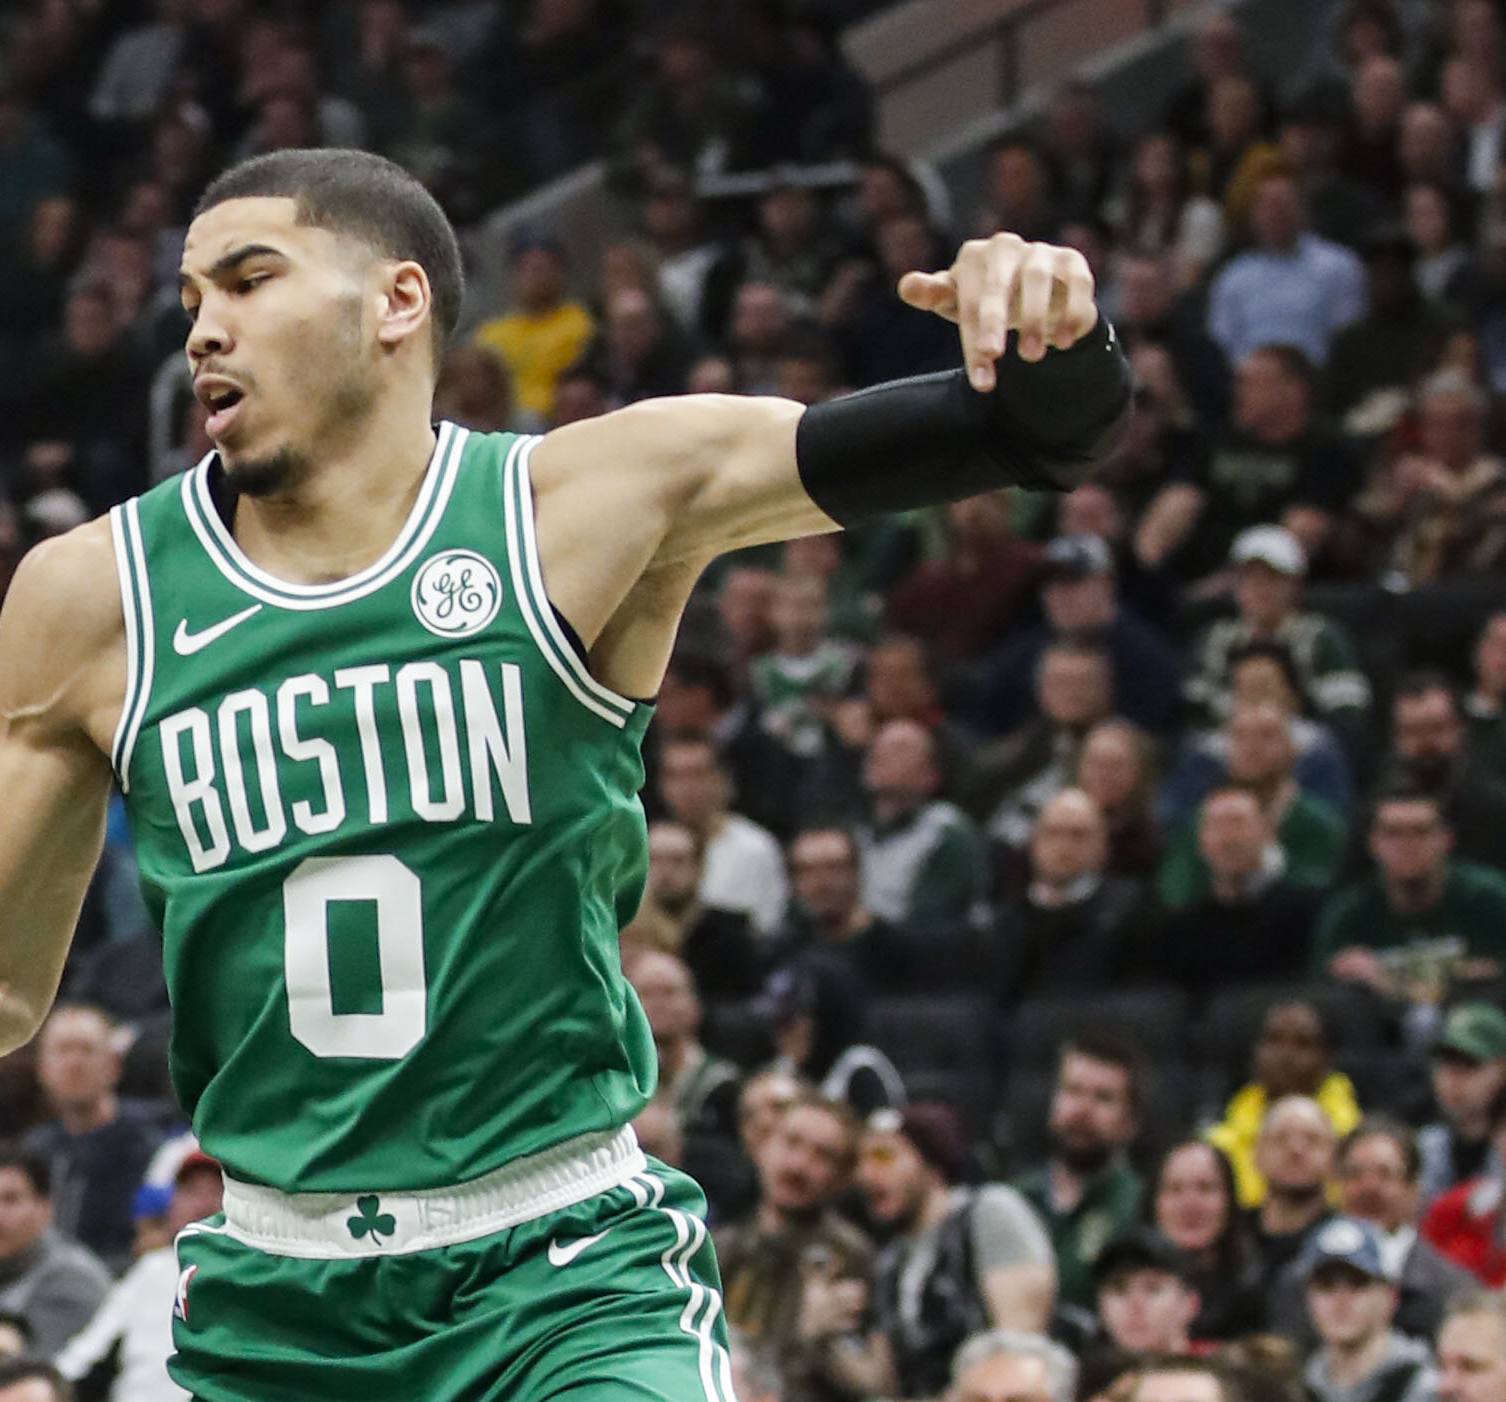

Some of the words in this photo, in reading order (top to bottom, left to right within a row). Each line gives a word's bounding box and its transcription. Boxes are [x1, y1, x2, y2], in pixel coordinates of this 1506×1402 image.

[432, 568, 483, 619] GE
[159, 659, 533, 874] BOSTON
[282, 853, 427, 1060] 0
